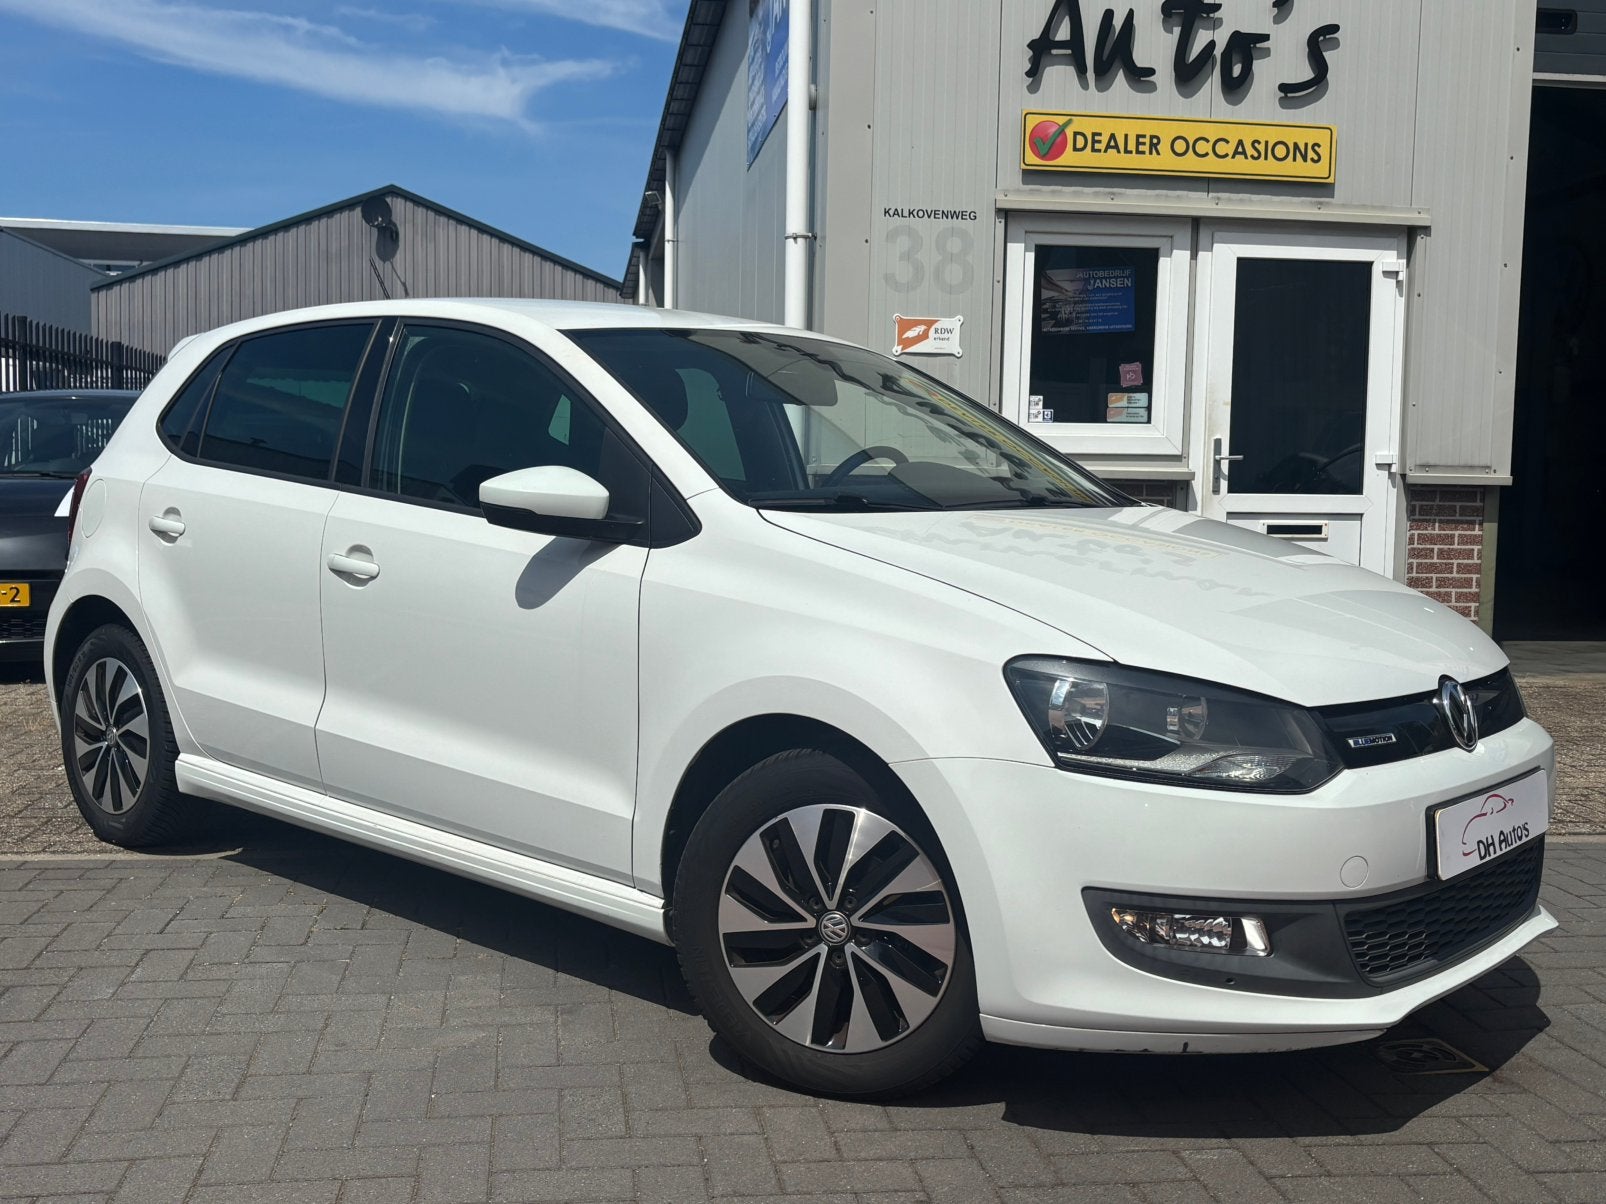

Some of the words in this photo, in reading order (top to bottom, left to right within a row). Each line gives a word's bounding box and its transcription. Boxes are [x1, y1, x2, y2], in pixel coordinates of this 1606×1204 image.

[1072, 131, 1162, 157] DEALER
[1170, 135, 1322, 164] OCCASIONS
[883, 207, 978, 221] KALKOVENWEG
[883, 225, 975, 296] 38
[1076, 269, 1132, 279] AUTOBEDRIJF
[1087, 278, 1132, 291] JANSEN
[934, 327, 955, 335] RDW
[1477, 834, 1497, 861] DH
[1498, 822, 1530, 852] Auto's
